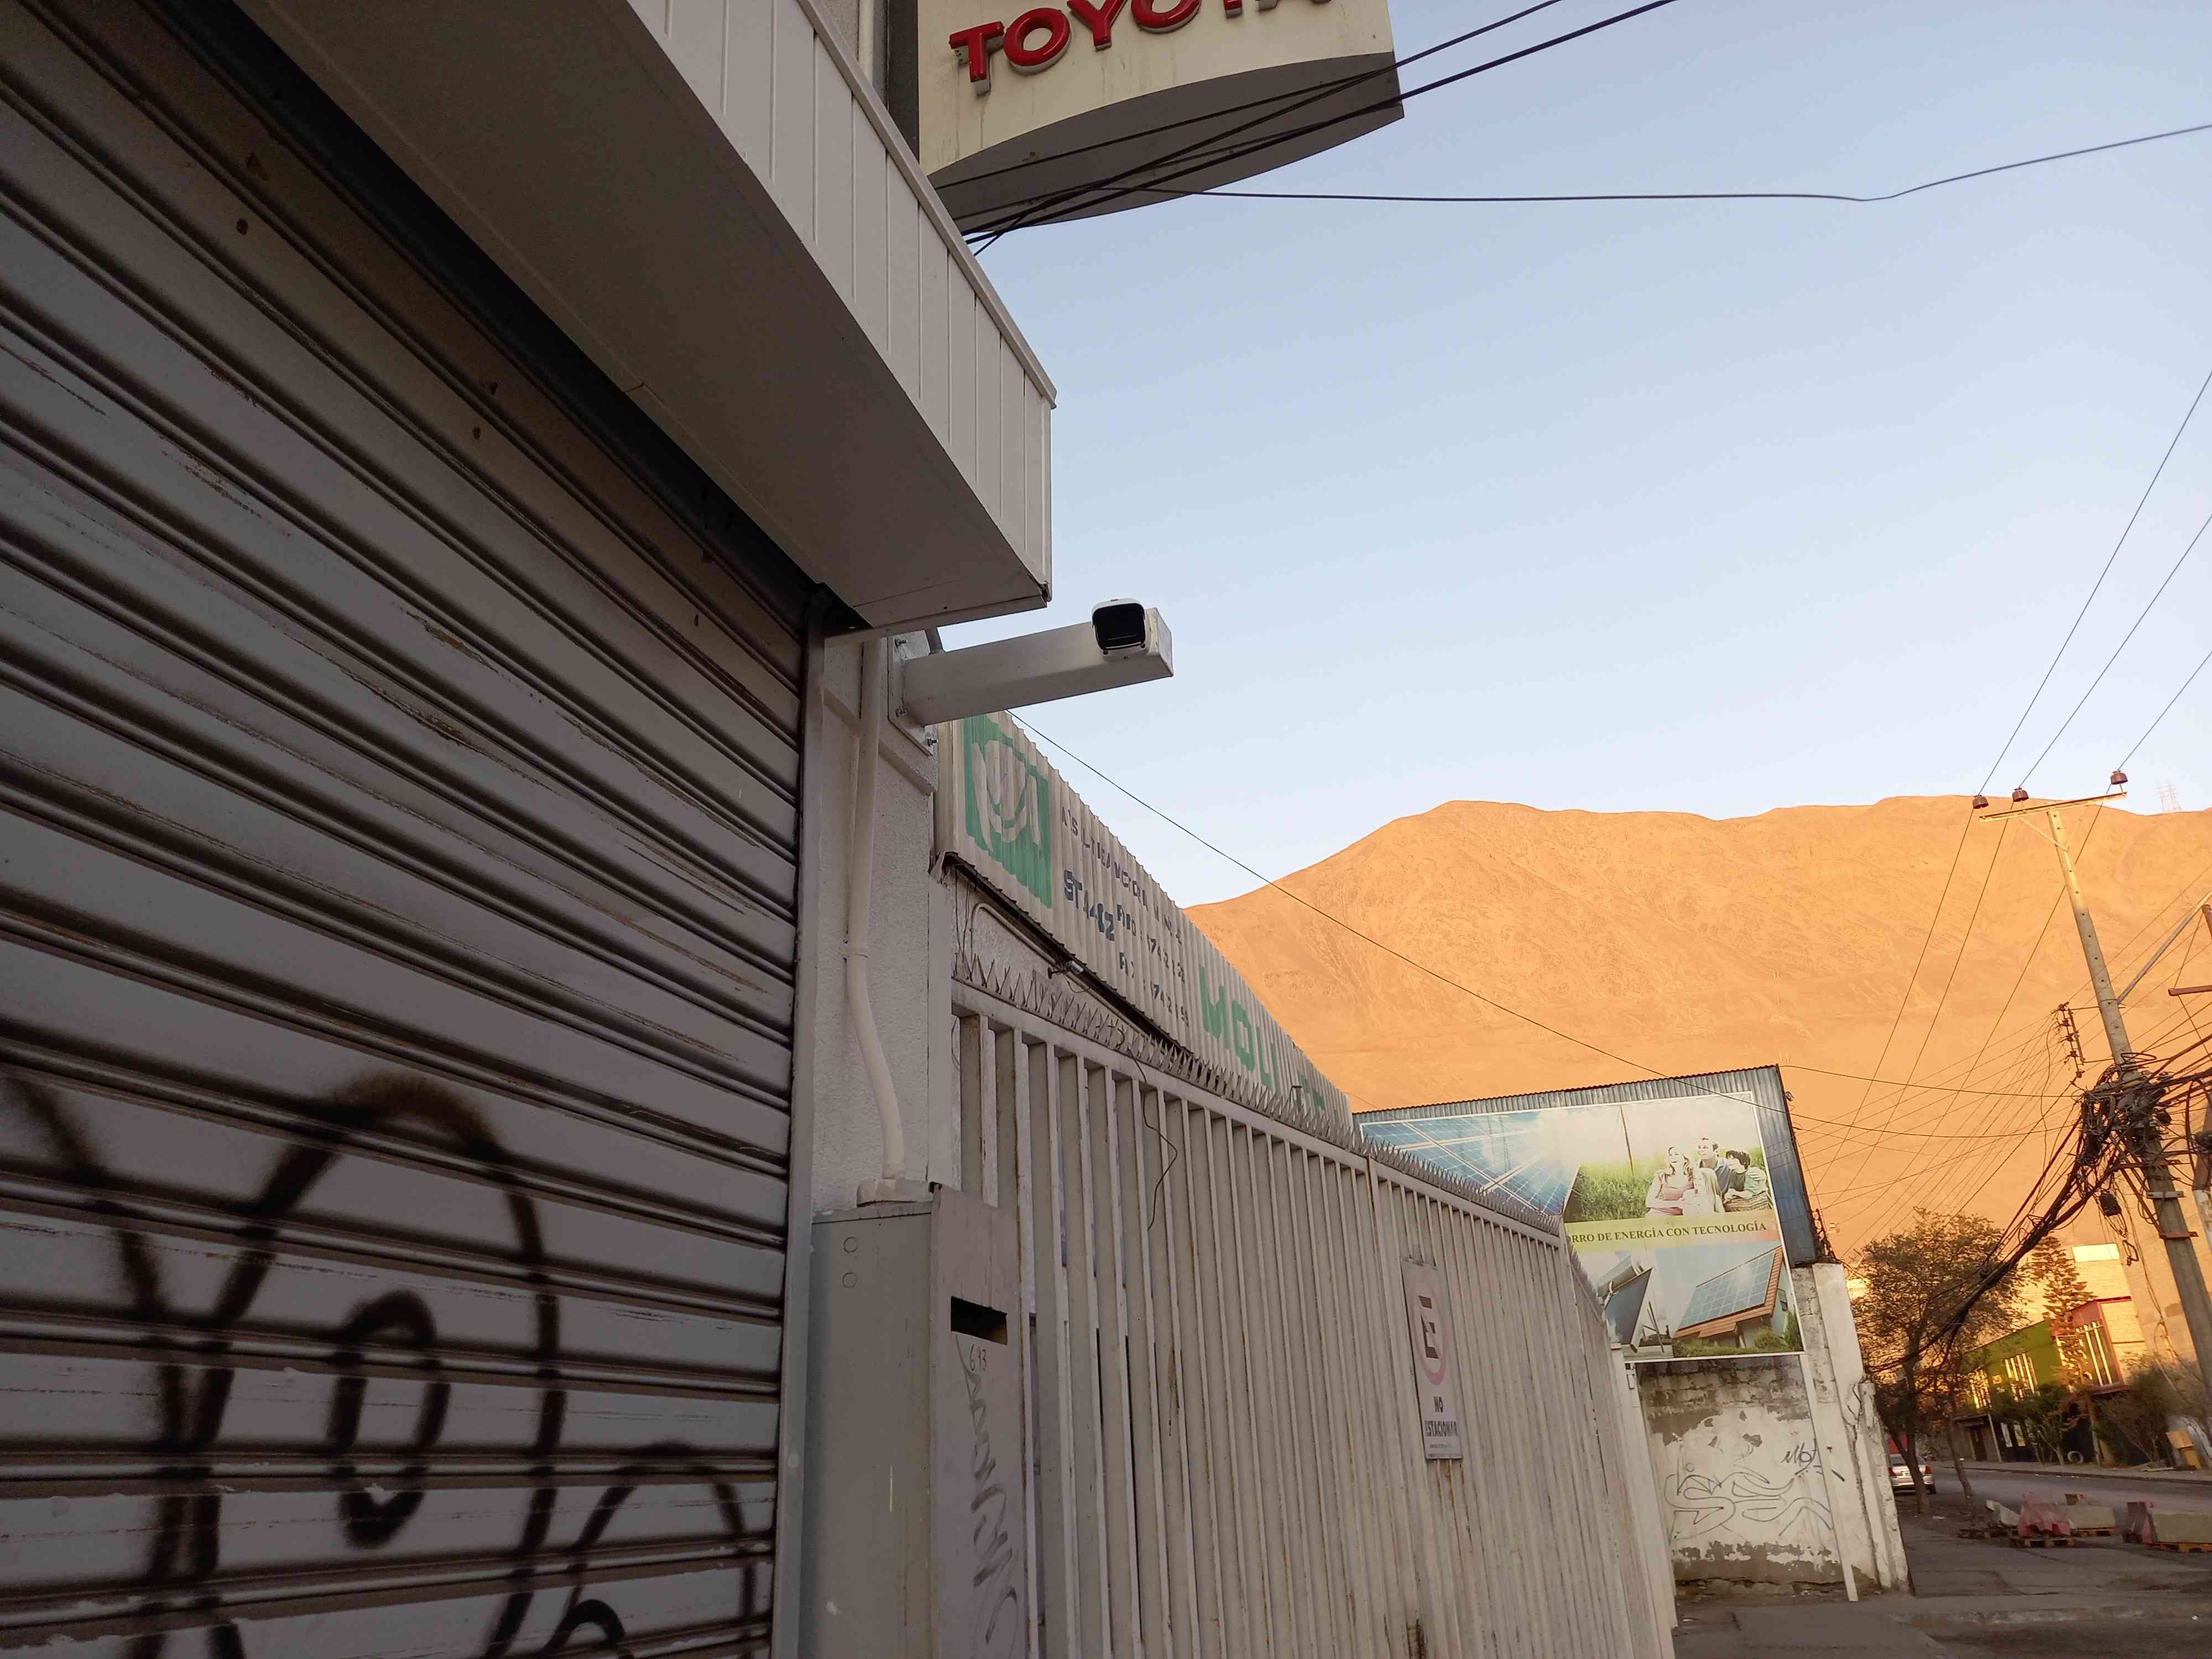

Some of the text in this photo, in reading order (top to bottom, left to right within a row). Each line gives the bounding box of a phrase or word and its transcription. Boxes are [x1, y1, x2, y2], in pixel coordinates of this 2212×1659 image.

[1597, 1233, 1612, 1242] DE
[1614, 1228, 1664, 1240] ENERGÍA
[1666, 1227, 1691, 1238] CON
[1692, 1220, 1767, 1235] TECNOLOGÍA
[1433, 1396, 1443, 1413] NO
